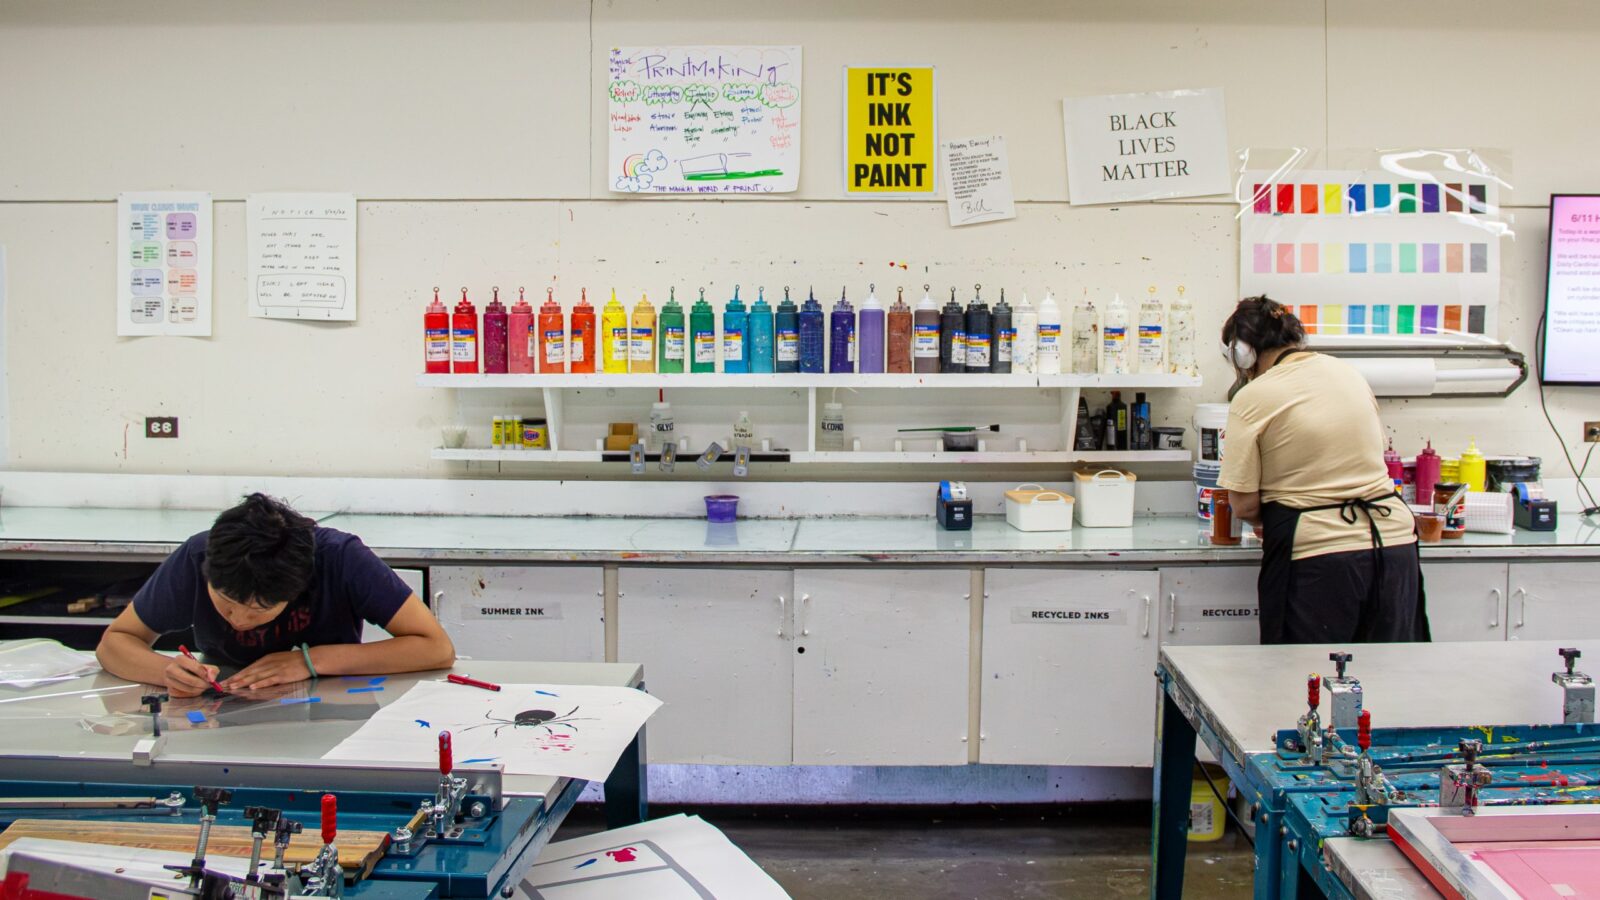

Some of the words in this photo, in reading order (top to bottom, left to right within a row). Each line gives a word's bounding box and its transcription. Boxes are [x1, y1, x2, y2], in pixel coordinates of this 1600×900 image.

[868, 72, 912, 96] IT'S
[868, 103, 912, 126] INK
[1109, 111, 1177, 132] BLACK
[866, 133, 915, 156] NOT
[1118, 136, 1176, 156] LIVES
[855, 164, 926, 187] PAINT
[1102, 160, 1190, 182] MATTER
[1571, 214, 1592, 222] 6/11
[1032, 611, 1081, 619] RECYCLED
